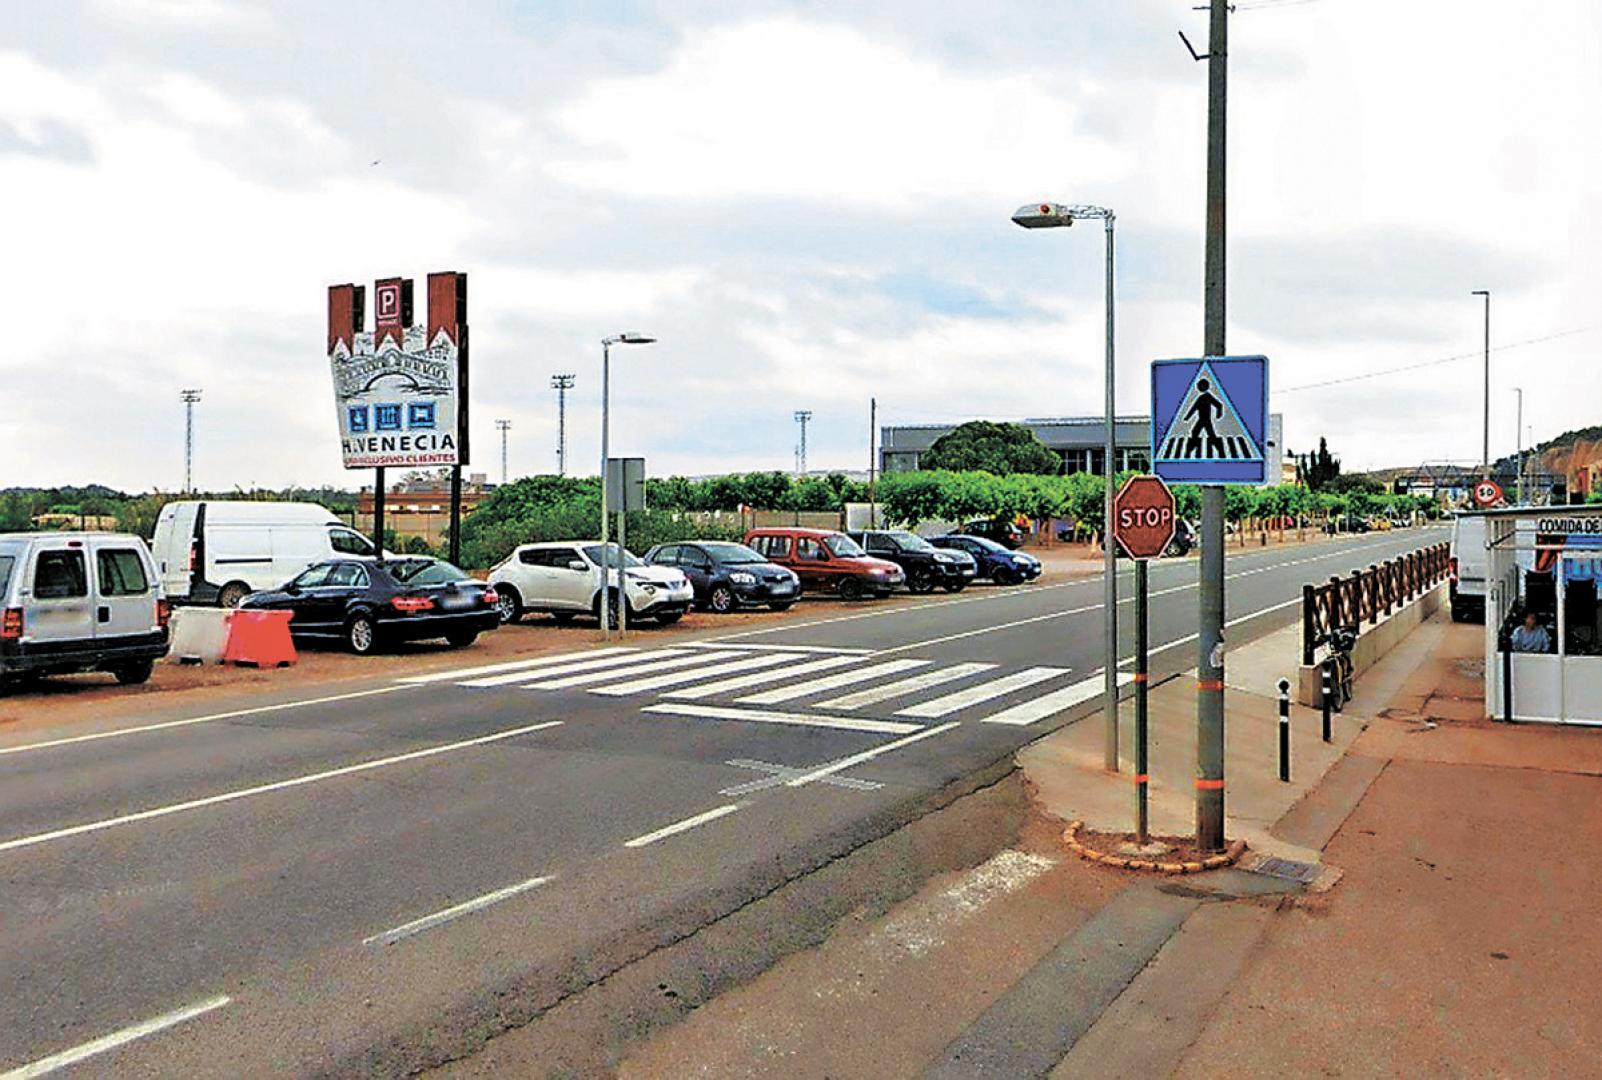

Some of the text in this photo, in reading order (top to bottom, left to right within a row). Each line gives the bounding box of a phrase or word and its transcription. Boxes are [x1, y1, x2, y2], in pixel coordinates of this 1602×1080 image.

[382, 291, 395, 313] P
[406, 454, 456, 463] CLIENTES
[1120, 508, 1171, 527] STOP
[1540, 518, 1600, 533] COMIDA DE
